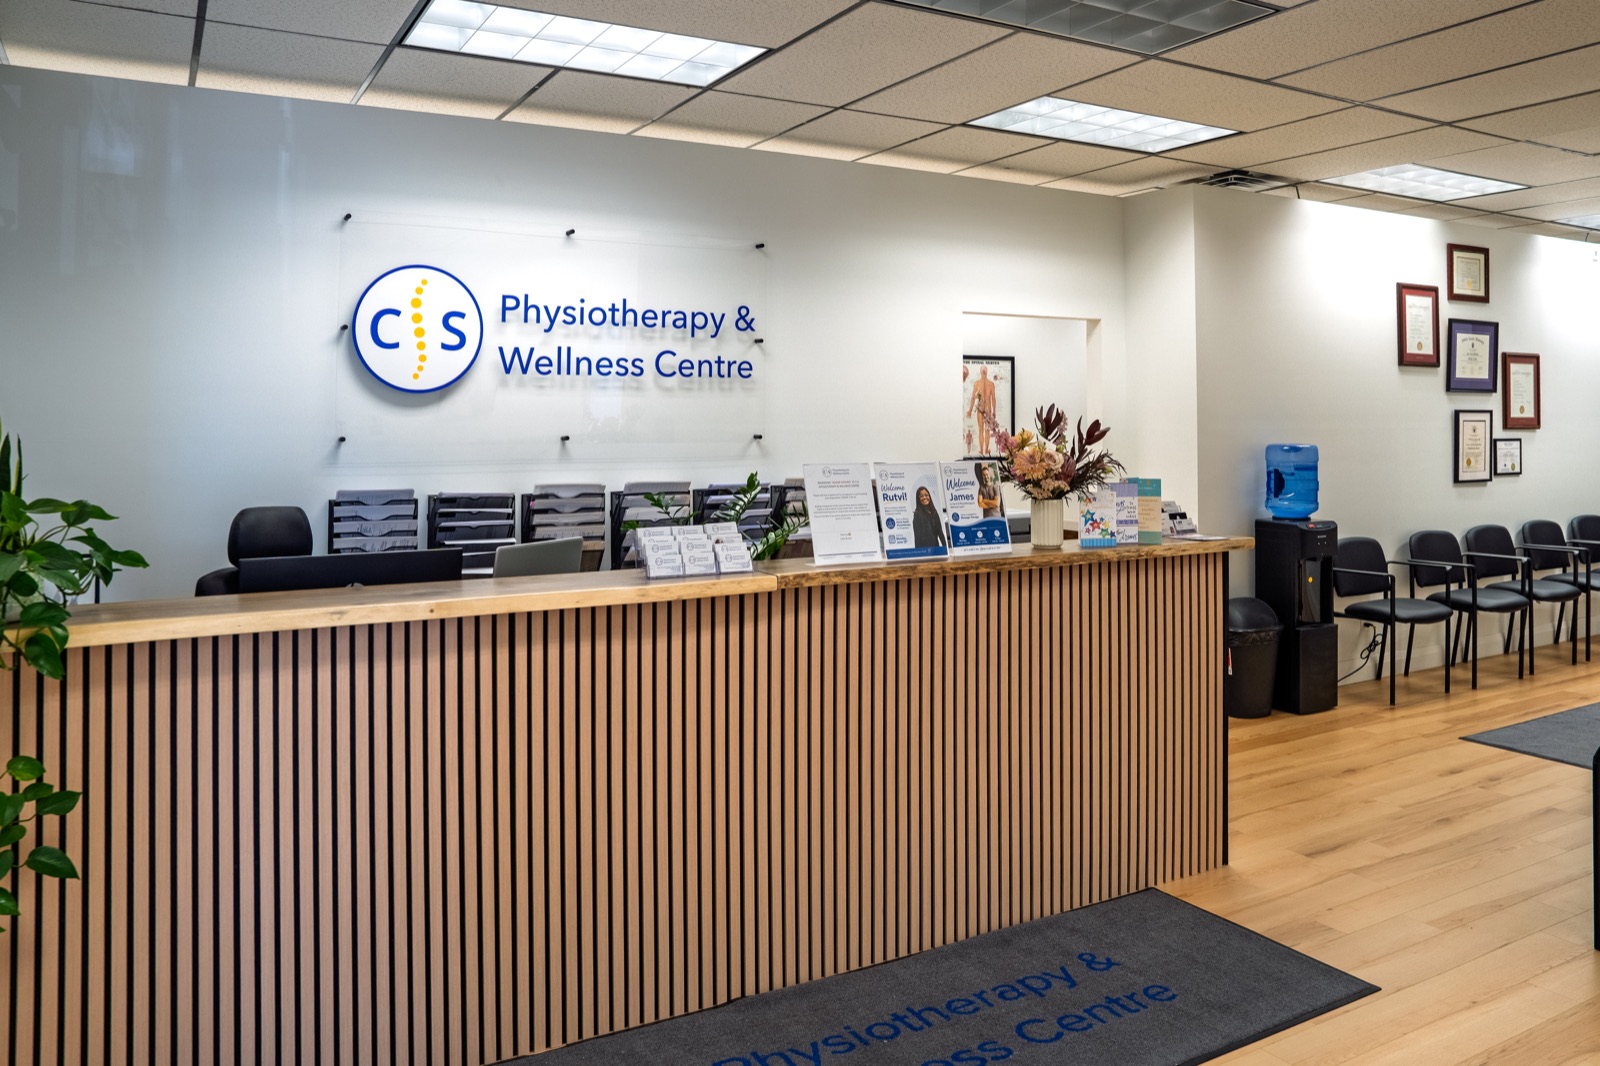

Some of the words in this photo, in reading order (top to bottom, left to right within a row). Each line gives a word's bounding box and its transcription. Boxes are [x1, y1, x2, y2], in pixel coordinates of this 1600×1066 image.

[501, 294, 725, 338] Physiotherapy
[734, 305, 756, 332] &
[498, 346, 645, 377] Wellness
[654, 350, 754, 380] Centre
[880, 482, 905, 492] Welcome
[946, 478, 976, 491] Welcome
[882, 493, 908, 502] Rutvi!
[949, 493, 975, 502] James
[1078, 951, 1121, 973] &
[1014, 982, 1178, 1045] Centre
